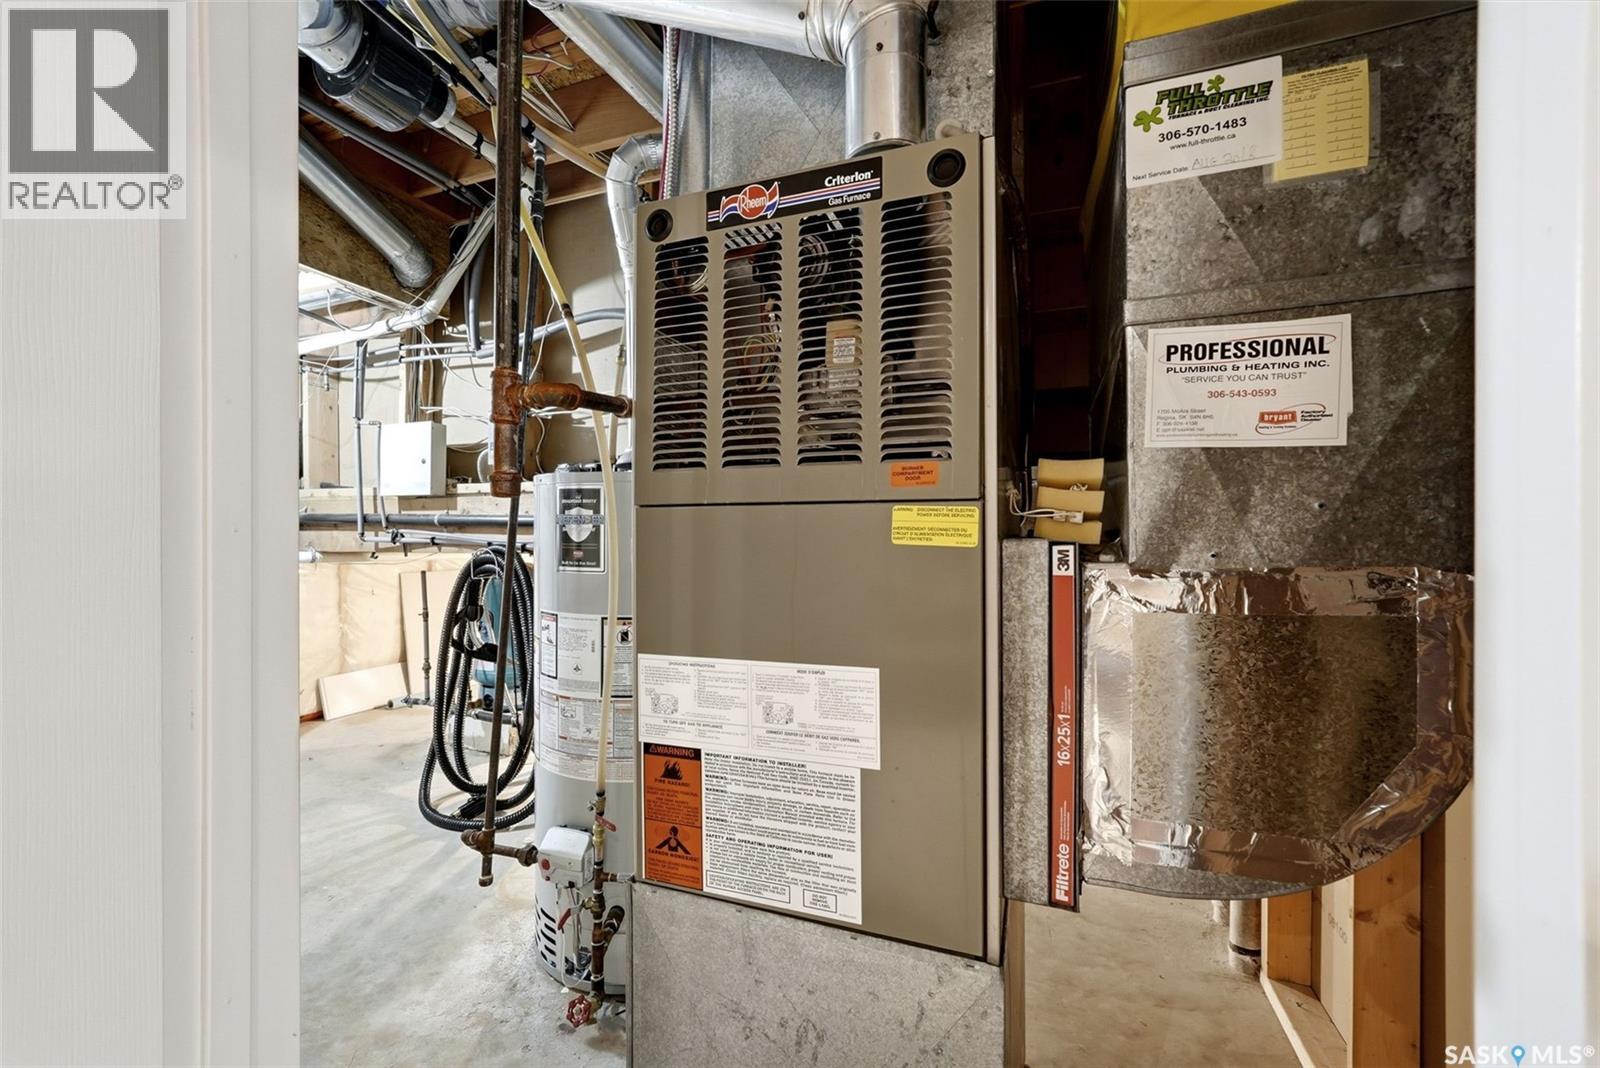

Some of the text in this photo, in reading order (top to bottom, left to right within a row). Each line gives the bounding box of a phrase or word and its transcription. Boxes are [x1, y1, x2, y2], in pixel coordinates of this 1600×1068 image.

[1156, 82, 1206, 105] FULL
[1168, 80, 1273, 116] THROTTLE
[1158, 117, 1247, 143] 306-570-1483
[1169, 133, 1236, 151] www.full-throttle.ca
[1132, 174, 1147, 182] Next
[1148, 169, 1171, 179] Service
[738, 193, 768, 212] Rheem
[828, 192, 871, 207] Gas Furnace
[1166, 335, 1329, 362] PROFESSIONAL
[1166, 364, 1227, 374] PLUMBING
[1245, 361, 1300, 371] HEATING
[1304, 360, 1330, 368] INC.
[1226, 374, 1246, 382] YOU
[1249, 373, 1269, 381] CAN
[1207, 388, 1277, 399] 306-543-0593
[1264, 411, 1292, 422] bryant
[1057, 549, 1070, 571] 3M
[1056, 714, 1071, 766] 16x25x1
[657, 745, 694, 758] WARNING
[705, 752, 732, 760] IMPORTANT
[733, 754, 767, 764] INFORMATION
[706, 833, 724, 841] SAFETY
[737, 837, 766, 848] OPERATING
[767, 842, 803, 854] INFORMATION
[1056, 843, 1070, 902] Filtrete
